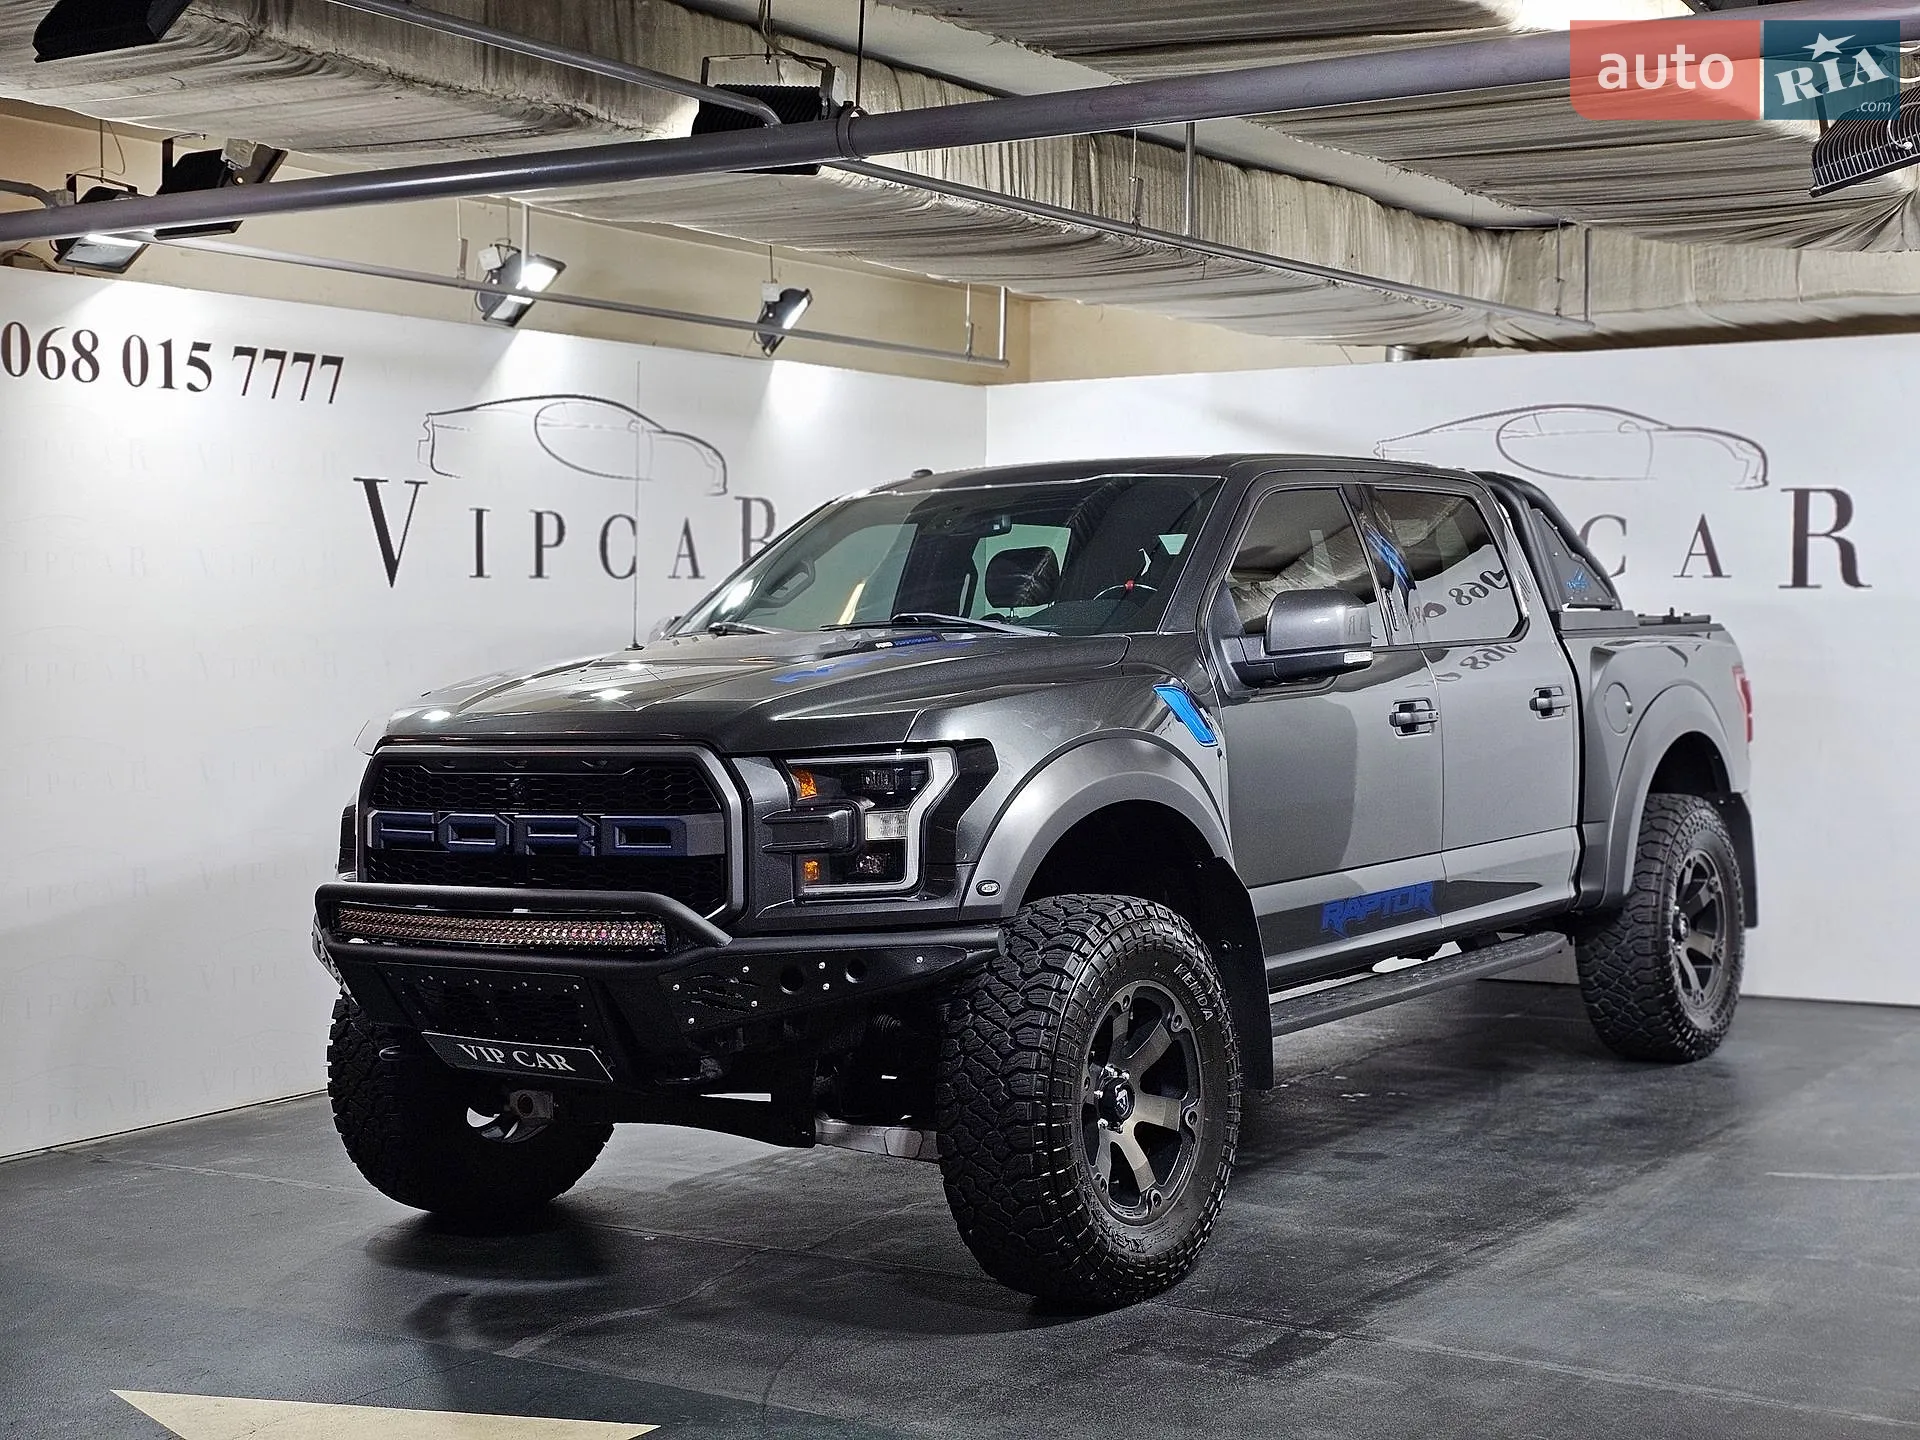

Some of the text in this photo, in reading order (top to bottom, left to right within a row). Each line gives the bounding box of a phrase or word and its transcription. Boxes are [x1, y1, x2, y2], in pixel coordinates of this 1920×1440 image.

[1, 321, 344, 404] 068 015 7777
[367, 810, 688, 856] FORD
[1321, 881, 1437, 939] RAPTOR
[1173, 963, 1214, 1021] KENDA
[456, 1043, 577, 1072] VIP CAR
